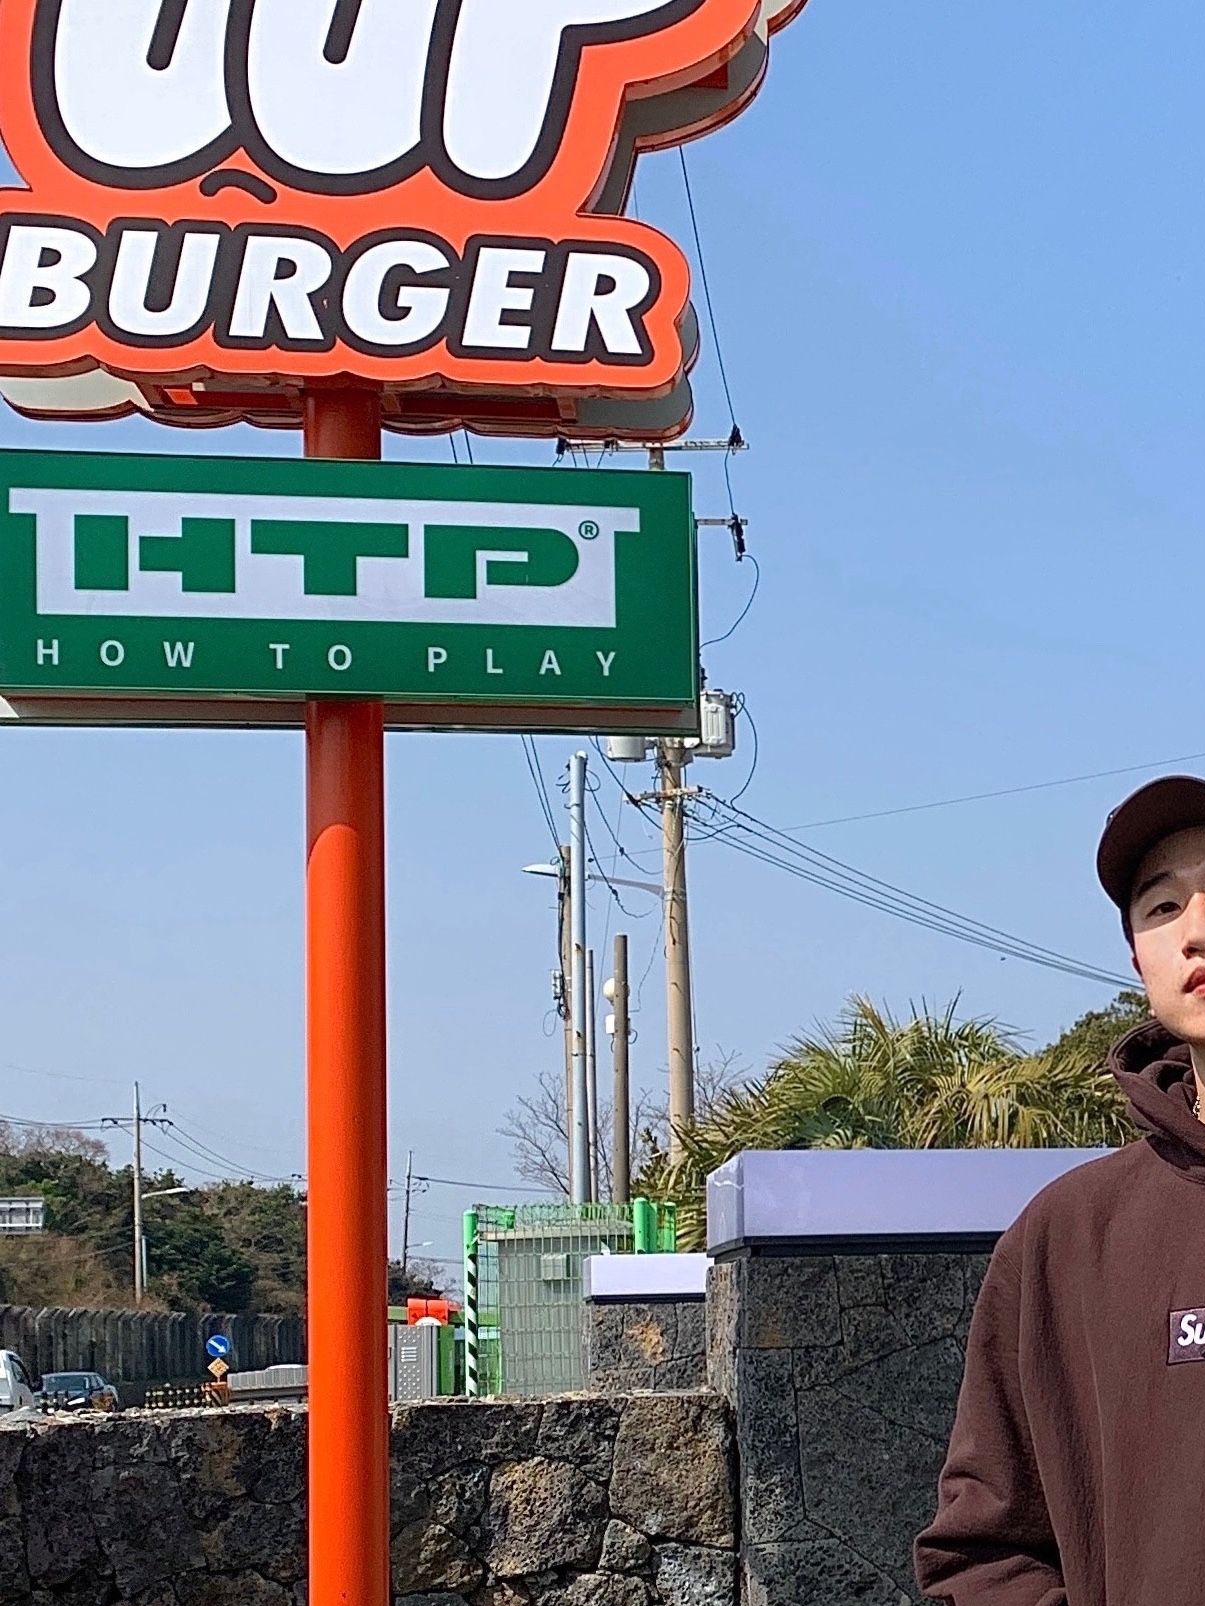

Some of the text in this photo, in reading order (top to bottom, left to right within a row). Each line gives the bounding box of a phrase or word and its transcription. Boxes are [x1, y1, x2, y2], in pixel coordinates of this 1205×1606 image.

[0, 225, 651, 355] BURGER
[36, 639, 616, 677] HOW TO PLAY
